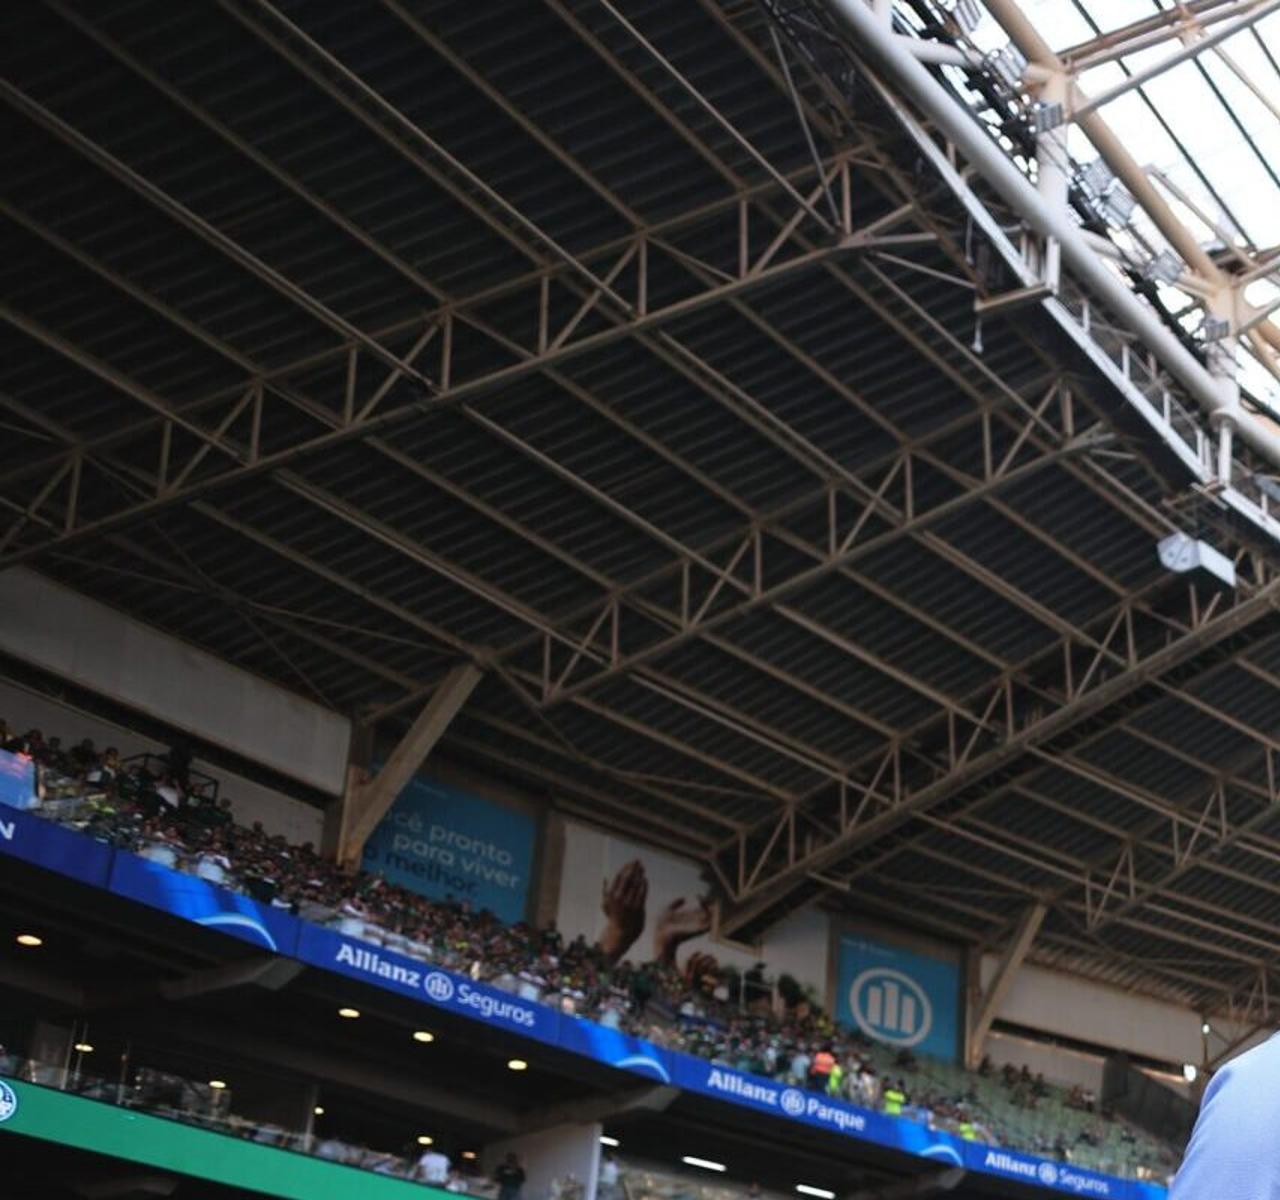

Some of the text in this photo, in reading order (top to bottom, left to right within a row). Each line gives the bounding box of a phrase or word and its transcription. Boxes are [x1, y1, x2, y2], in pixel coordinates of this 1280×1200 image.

[392, 834, 521, 889] para viver
[430, 825, 513, 866] pronto
[385, 852, 480, 894] melhor
[335, 942, 535, 1028] Allianz Seguros
[707, 1068, 865, 1131] Allianz Parque
[984, 1151, 1109, 1195] Allianz Seguros
